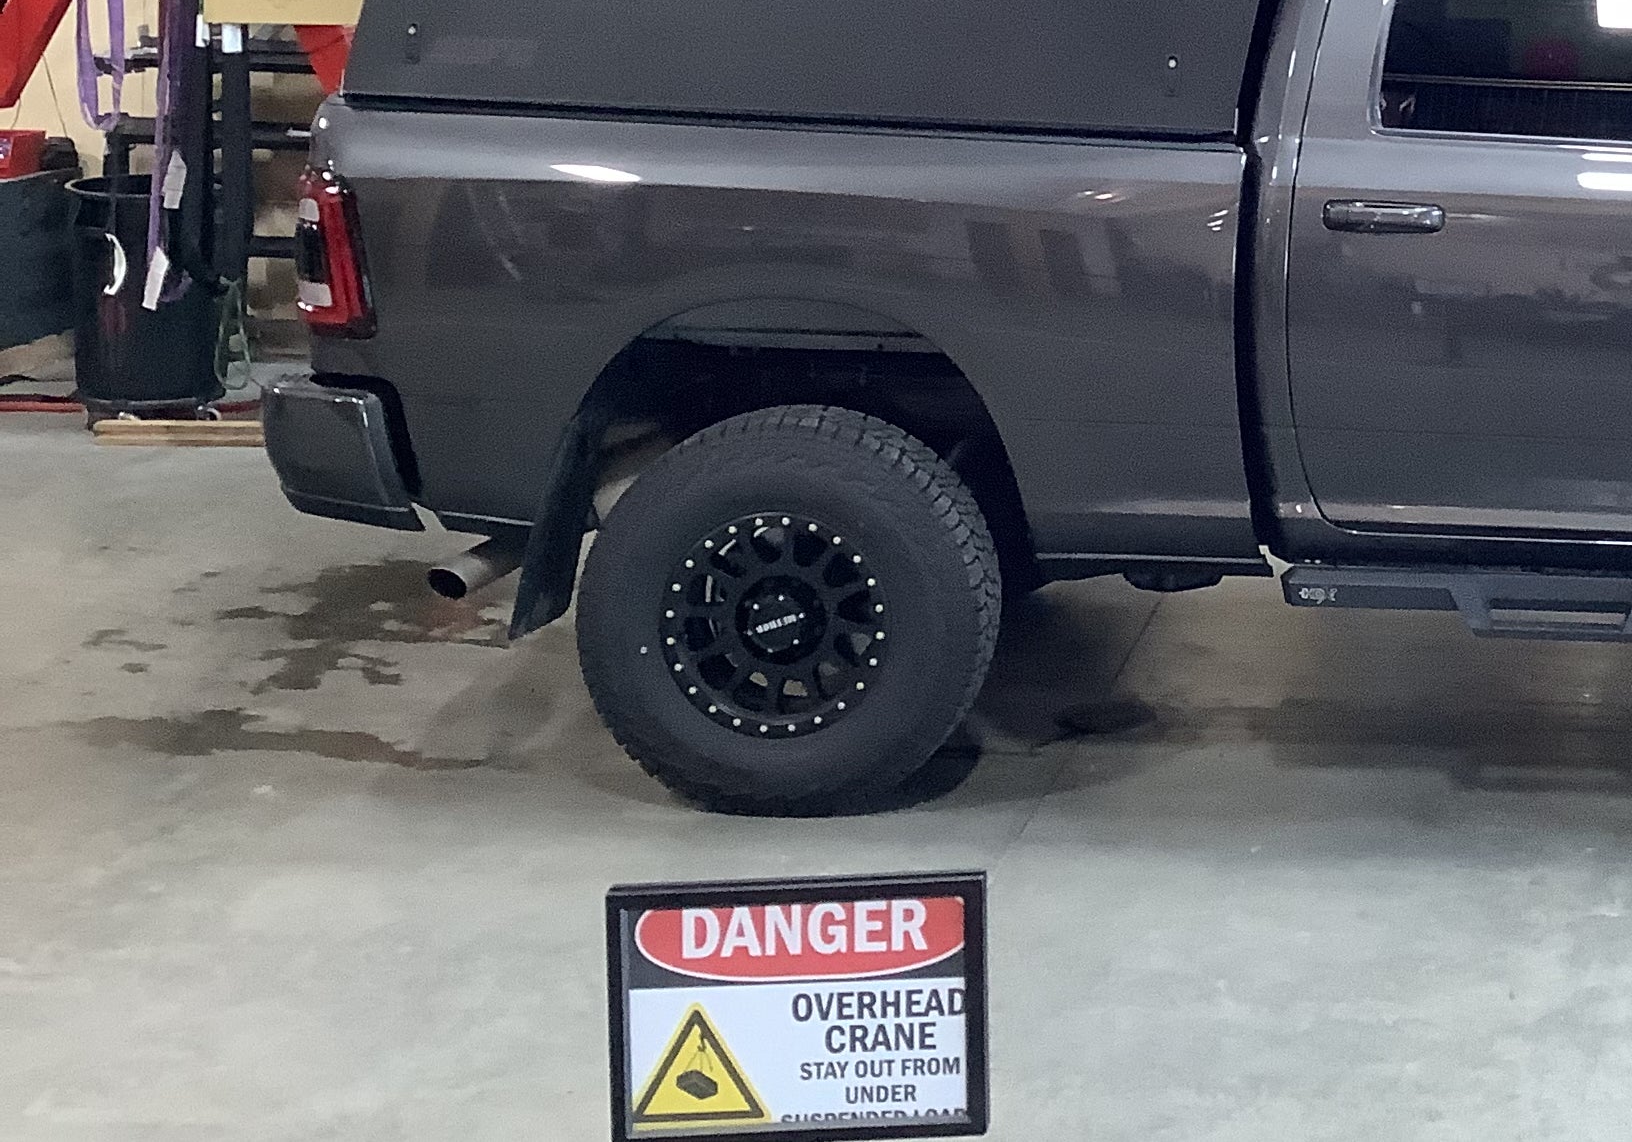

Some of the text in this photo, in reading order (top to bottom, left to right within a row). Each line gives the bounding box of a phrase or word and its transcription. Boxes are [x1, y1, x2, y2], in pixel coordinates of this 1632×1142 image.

[682, 899, 928, 960] DANGER
[792, 988, 965, 1022] OVERHEAD
[825, 1022, 937, 1054] CRANE
[800, 1057, 961, 1080] STAY OUT FROM
[845, 1084, 917, 1104] UNDER
